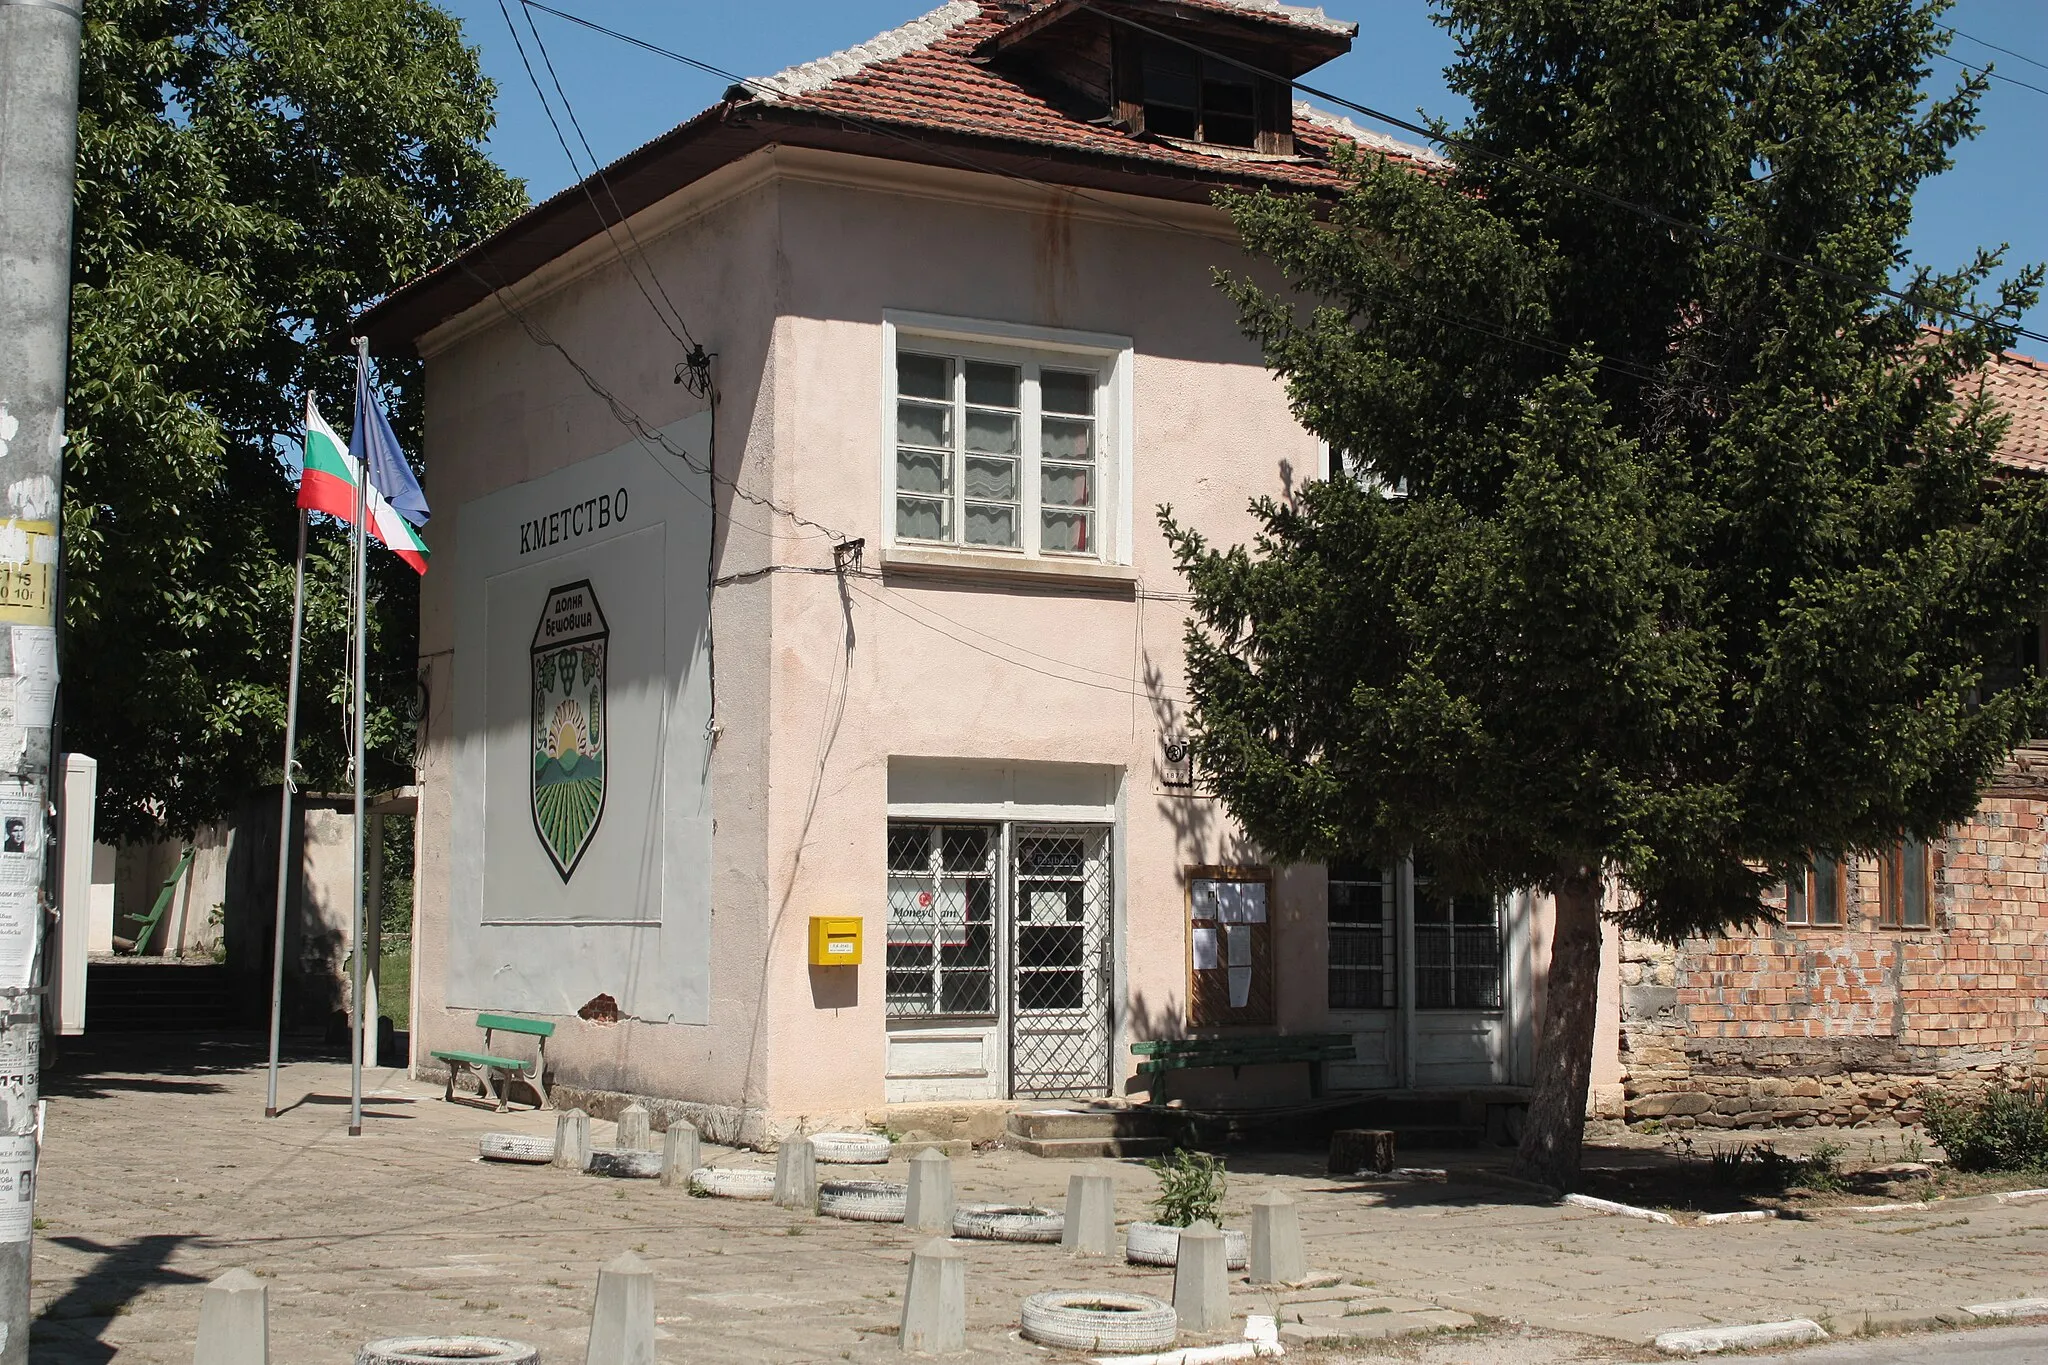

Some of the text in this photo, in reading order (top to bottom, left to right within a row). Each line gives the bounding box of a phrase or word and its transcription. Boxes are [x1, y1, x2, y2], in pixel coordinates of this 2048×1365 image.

[520, 488, 628, 555] КМЕТСТВО
[555, 594, 583, 614] ДОЛНА
[545, 612, 592, 637] БЕШОВИЦА
